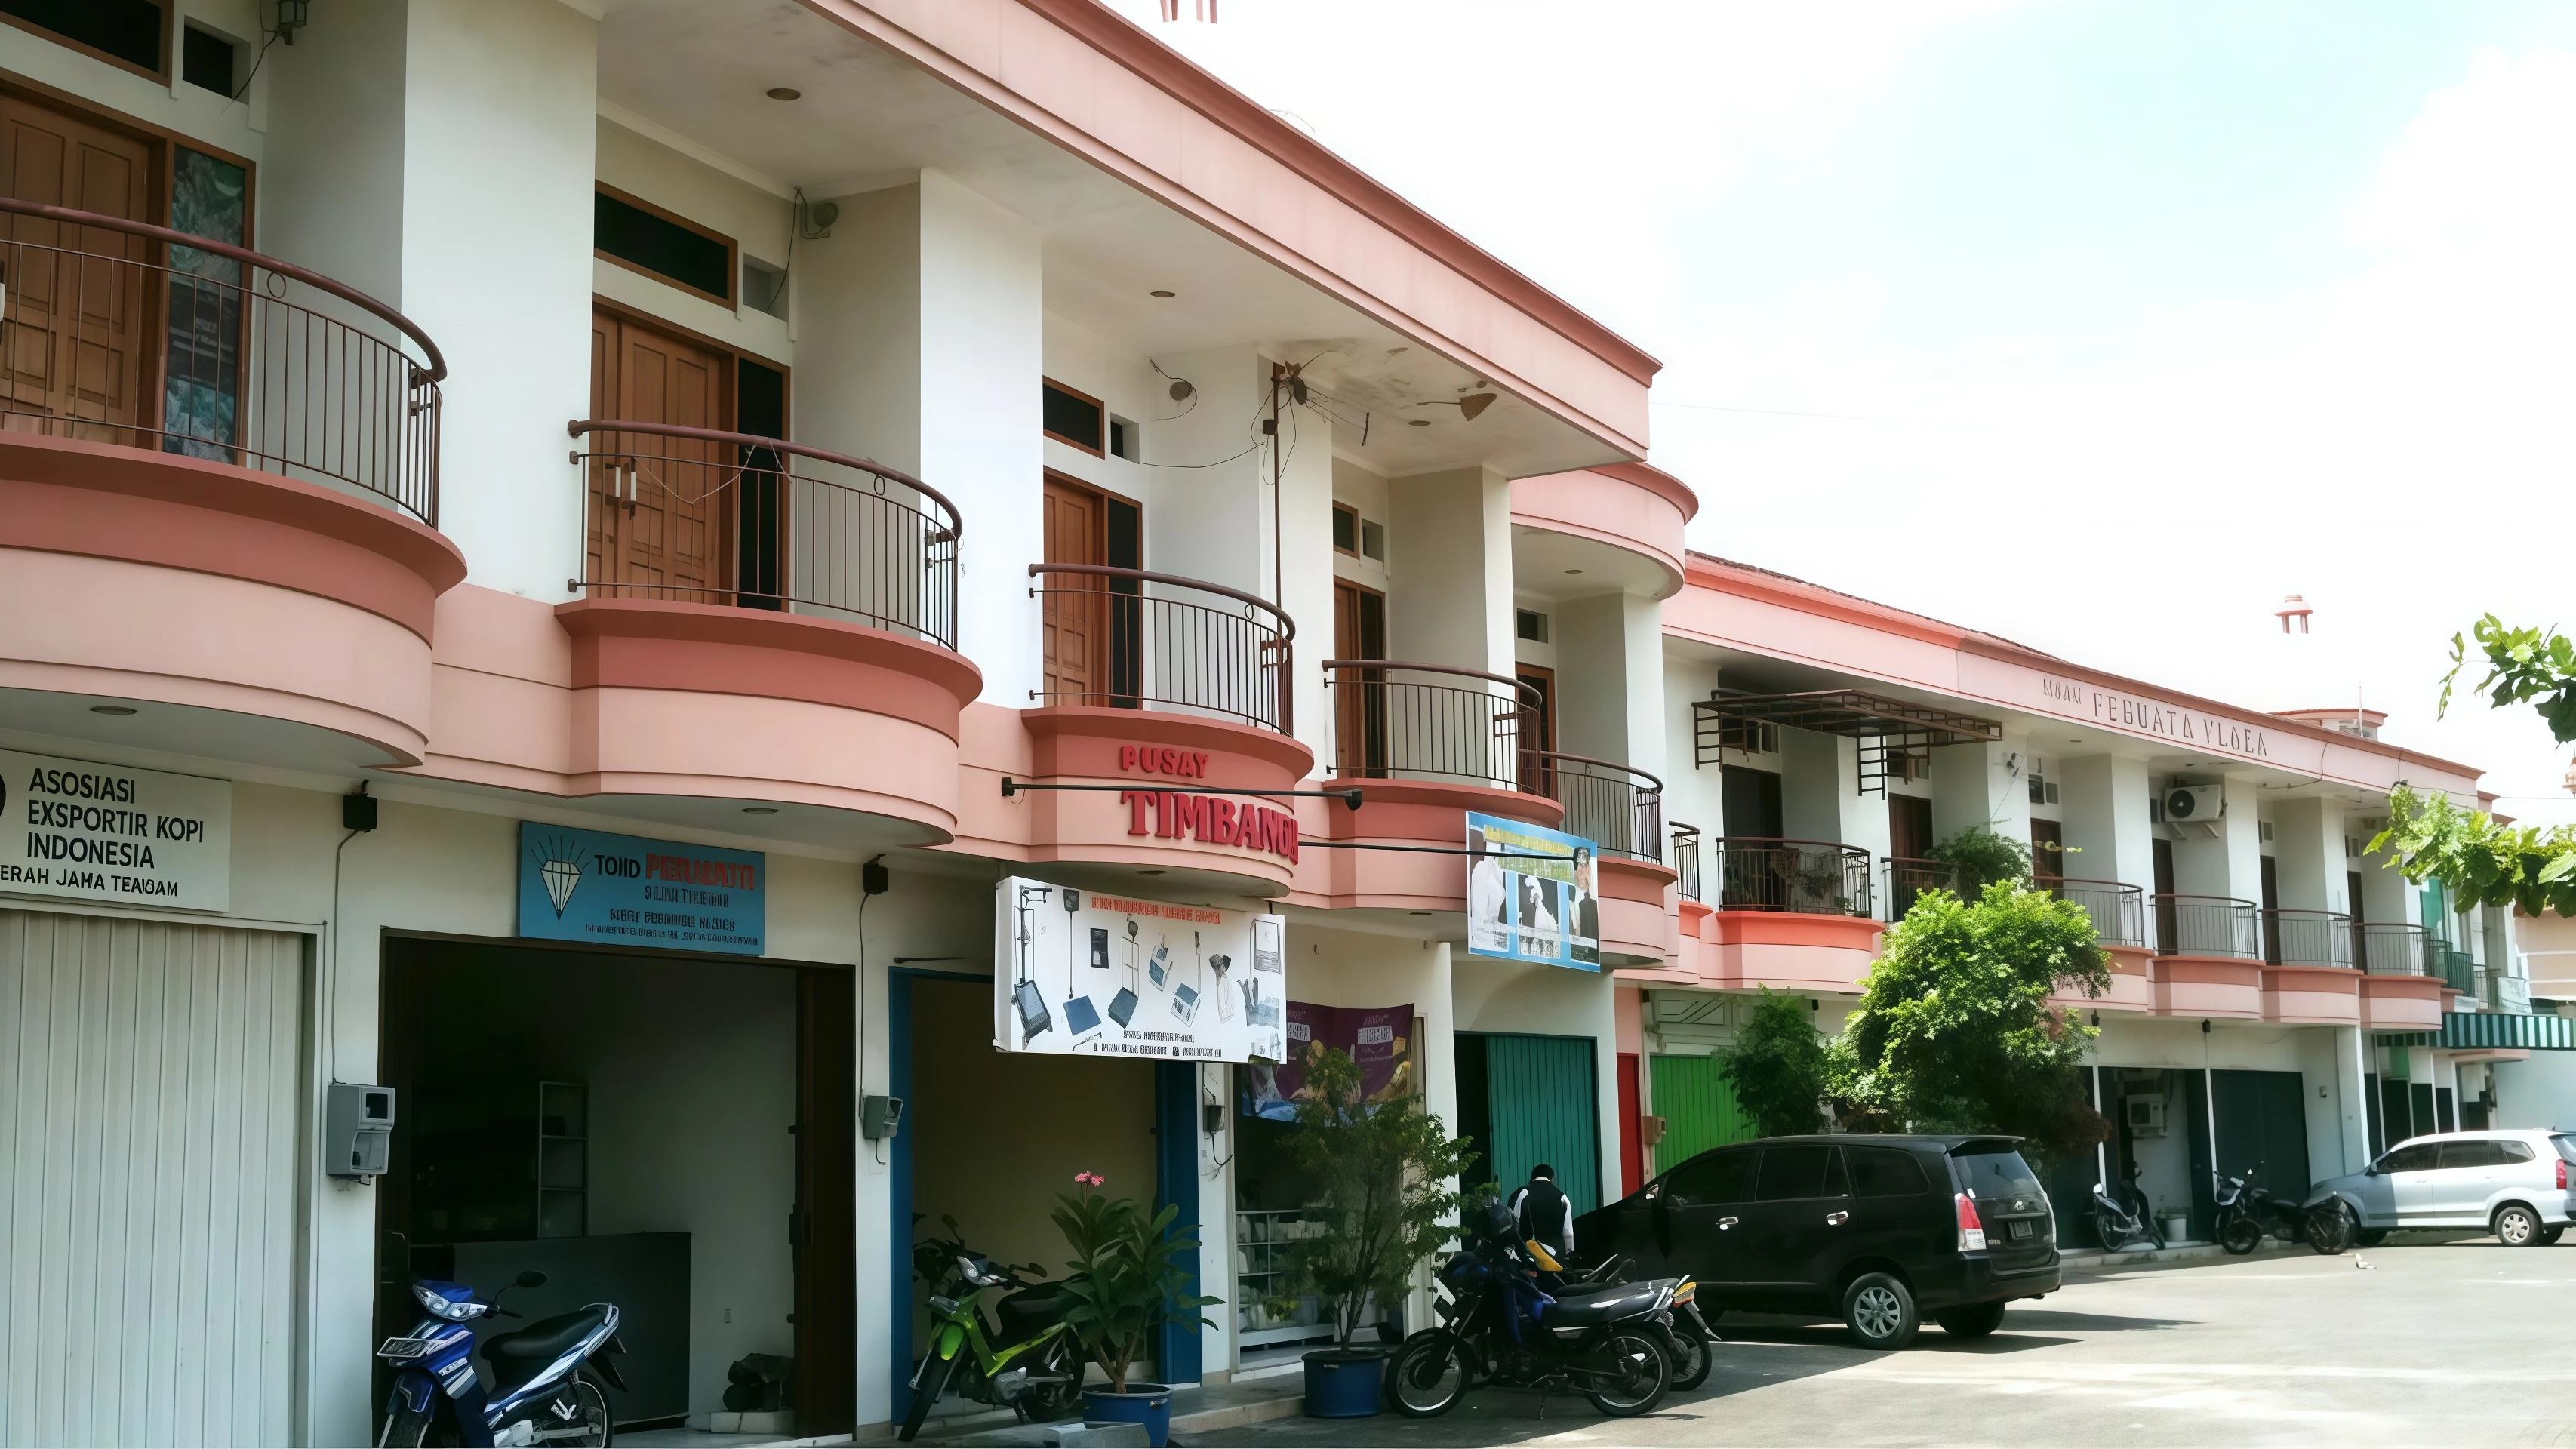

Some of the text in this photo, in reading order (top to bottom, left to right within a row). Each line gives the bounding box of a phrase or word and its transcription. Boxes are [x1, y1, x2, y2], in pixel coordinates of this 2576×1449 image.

[29, 768, 135, 804] ASOSIASI
[156, 815, 204, 843] KOPI
[27, 832, 155, 869] INDONESIA
